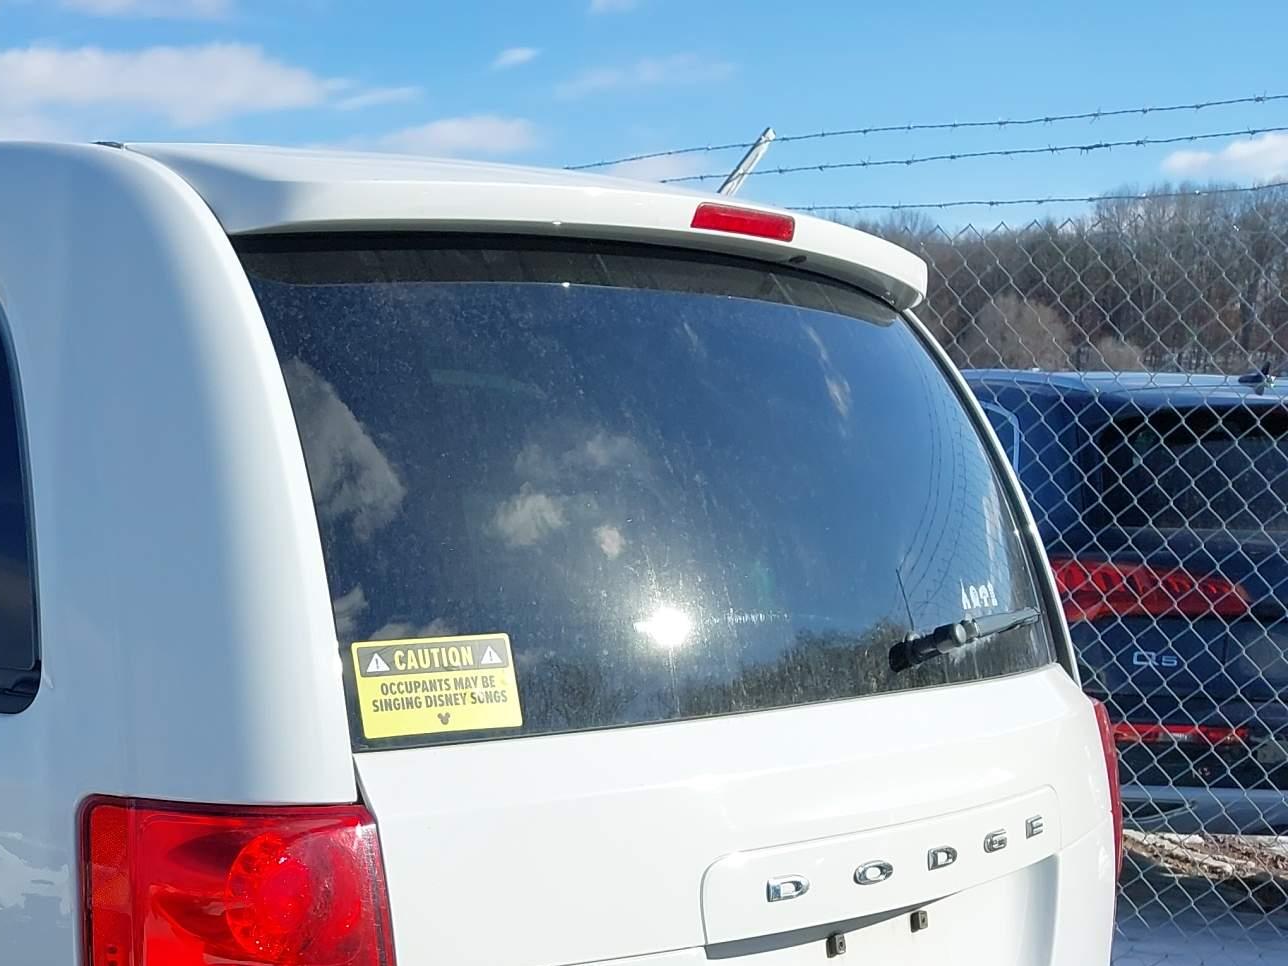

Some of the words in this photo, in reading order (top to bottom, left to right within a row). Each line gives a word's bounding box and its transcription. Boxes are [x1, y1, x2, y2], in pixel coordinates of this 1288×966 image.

[394, 646, 474, 671] CAUTION
[380, 678, 451, 696] OCCUPANTS
[454, 676, 479, 691] MAY
[482, 675, 495, 688] BE
[372, 696, 422, 712] SINGING
[426, 692, 467, 708] DISNEY
[766, 815, 1045, 902] DODGE
